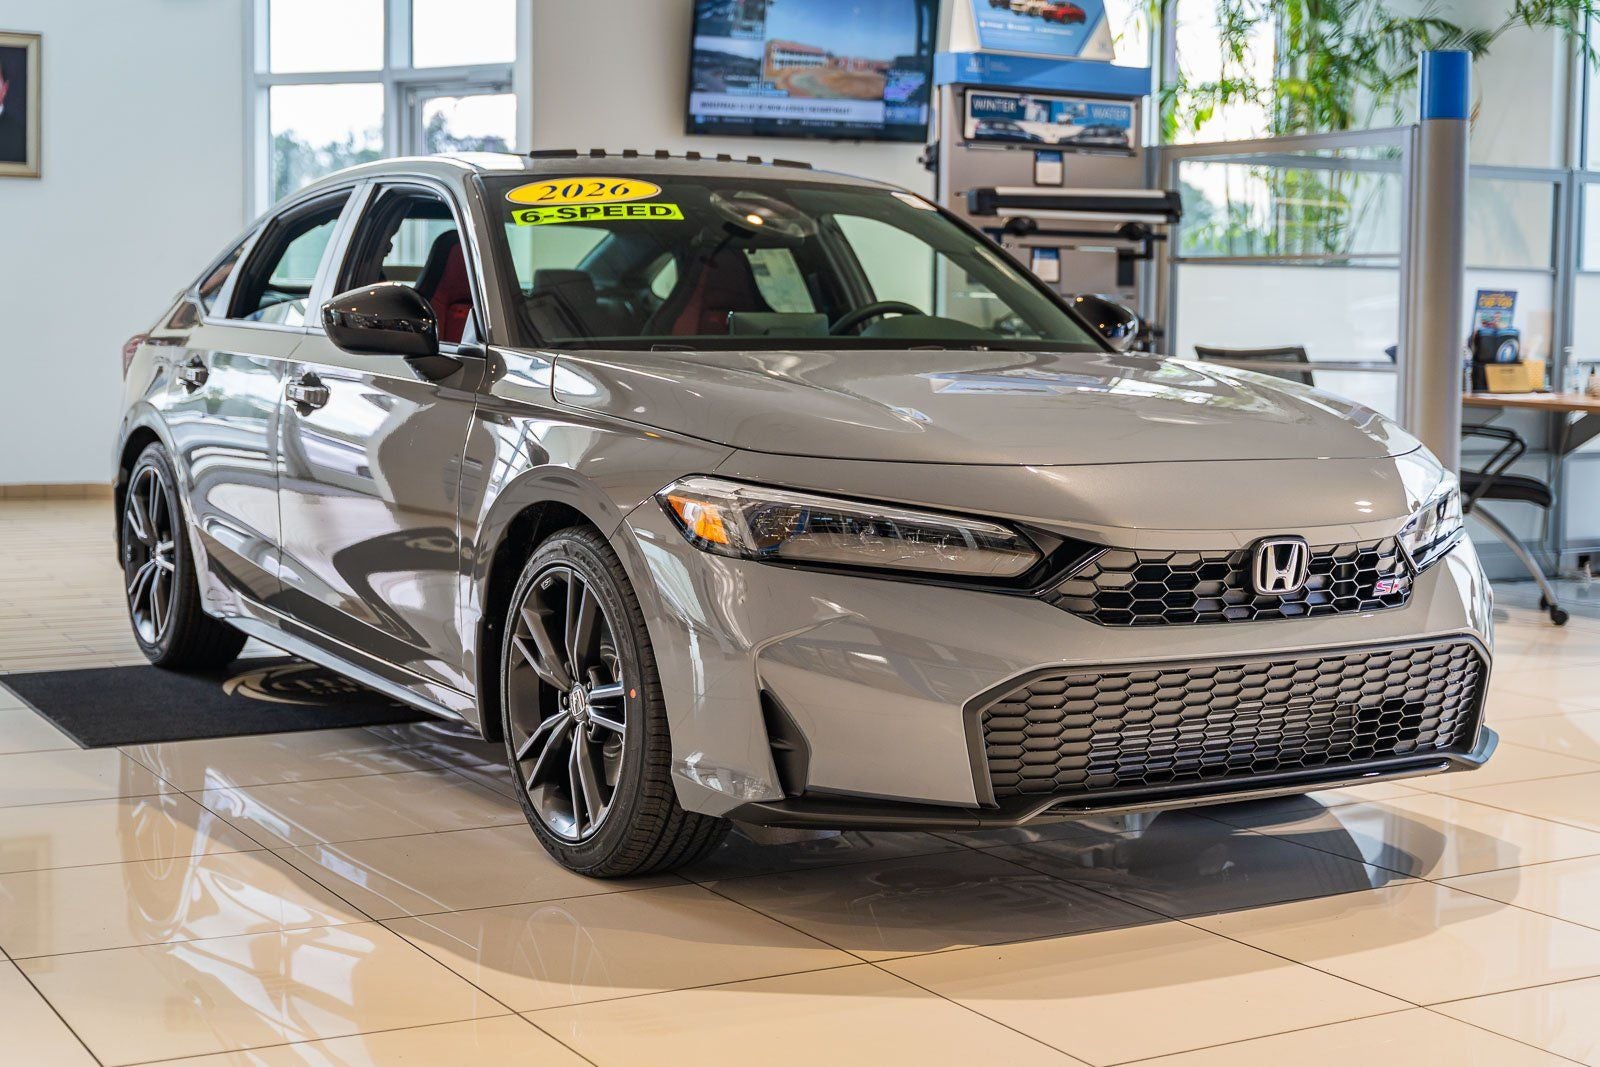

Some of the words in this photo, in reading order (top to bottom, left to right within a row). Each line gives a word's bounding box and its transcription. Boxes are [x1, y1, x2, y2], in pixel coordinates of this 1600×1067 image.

[973, 98, 1016, 113] WINTER
[537, 182, 630, 202] 2026
[520, 205, 674, 223] 6-SPEED
